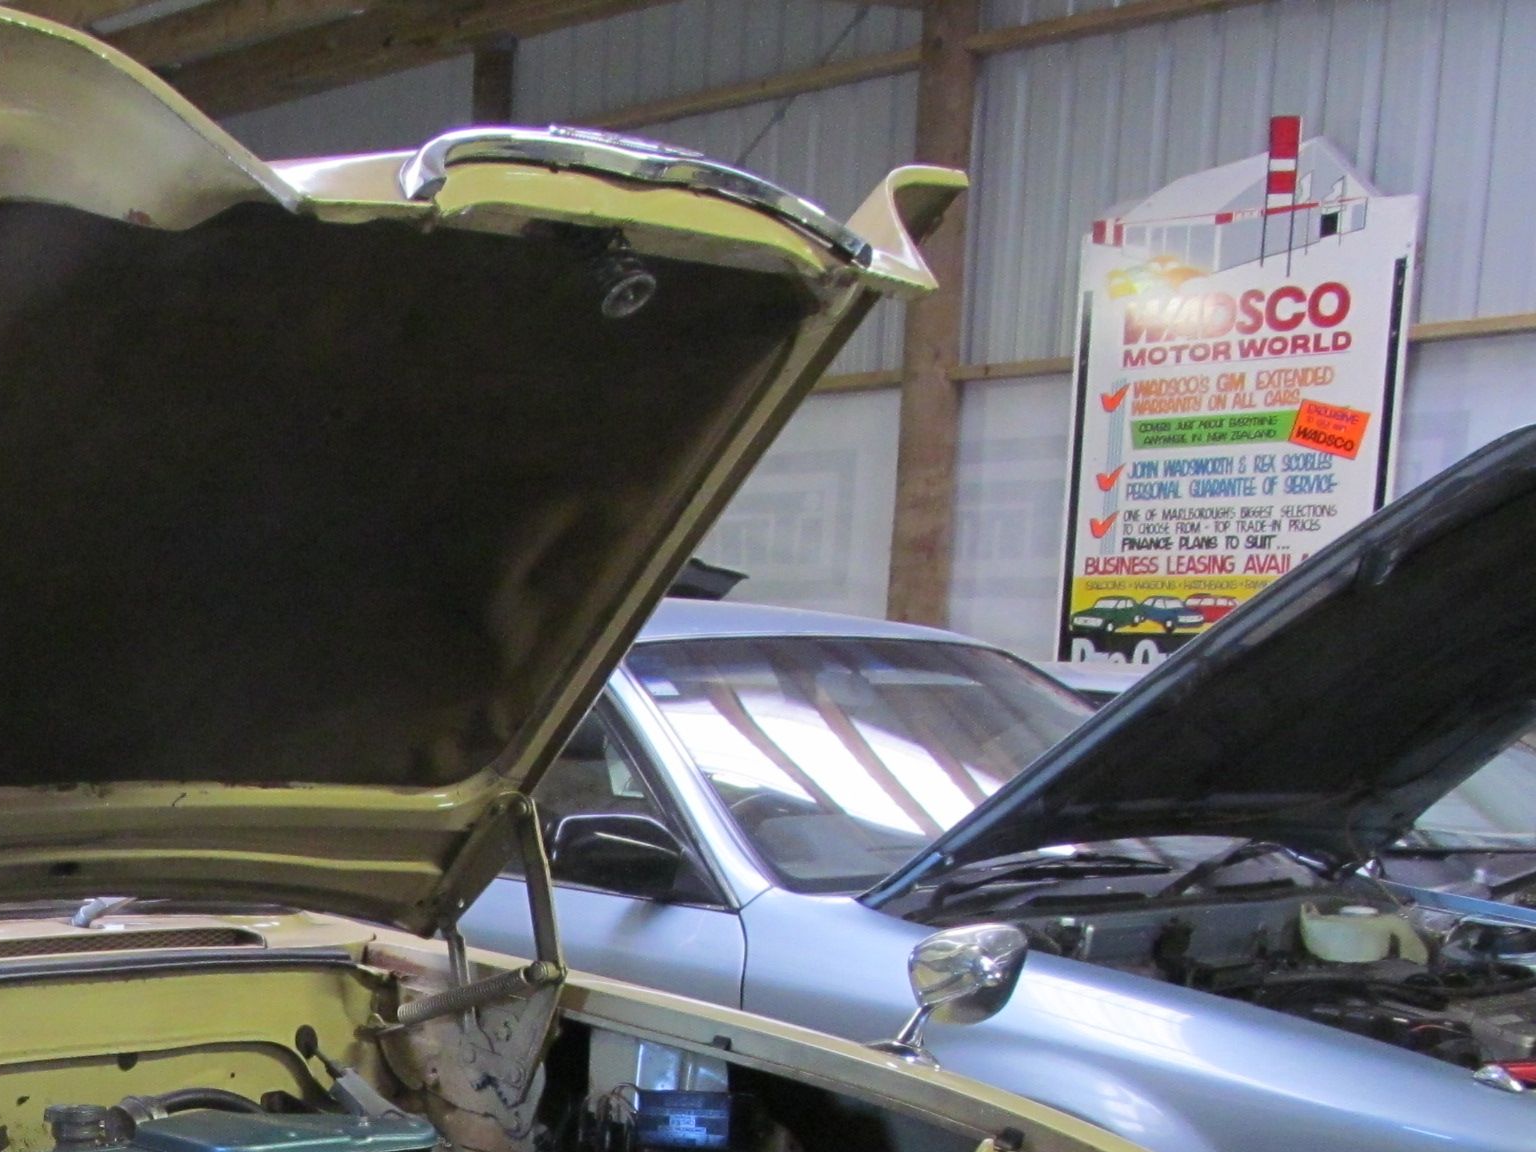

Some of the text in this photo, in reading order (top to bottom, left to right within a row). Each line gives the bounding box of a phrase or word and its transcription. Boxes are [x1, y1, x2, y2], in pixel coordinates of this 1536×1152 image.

[1123, 281, 1352, 346] WADSCO
[1122, 331, 1353, 368] MOTOR WORLD
[1216, 373, 1246, 392] GM
[1255, 366, 1336, 390] EXTENDED
[1131, 388, 1301, 416] WARRANTY ON ALL CARS
[1295, 426, 1354, 451] WADSCO
[1127, 460, 1159, 480] JOHN
[1163, 456, 1234, 478] WADSWORTH
[1254, 454, 1276, 473] REX
[1126, 473, 1338, 501] PERSONAL GUARANTEE OF SERVICE
[1123, 508, 1141, 522] ONE
[1145, 507, 1158, 521] OF
[1240, 505, 1274, 518] BIGGEST
[1280, 504, 1338, 517] SELECTIONS
[1123, 523, 1133, 535] TO
[1139, 521, 1170, 535] CHOOSE
[1175, 520, 1201, 534] FROM
[1214, 520, 1229, 533] TOP
[1236, 519, 1282, 533] TRADE-IN
[1288, 518, 1322, 531] PRICES
[1121, 535, 1174, 552] FINANCE
[1178, 535, 1218, 551] PLANS
[1225, 534, 1240, 549] TO
[1084, 555, 1159, 576] BUSINESS
[1166, 554, 1235, 576] LEASING
